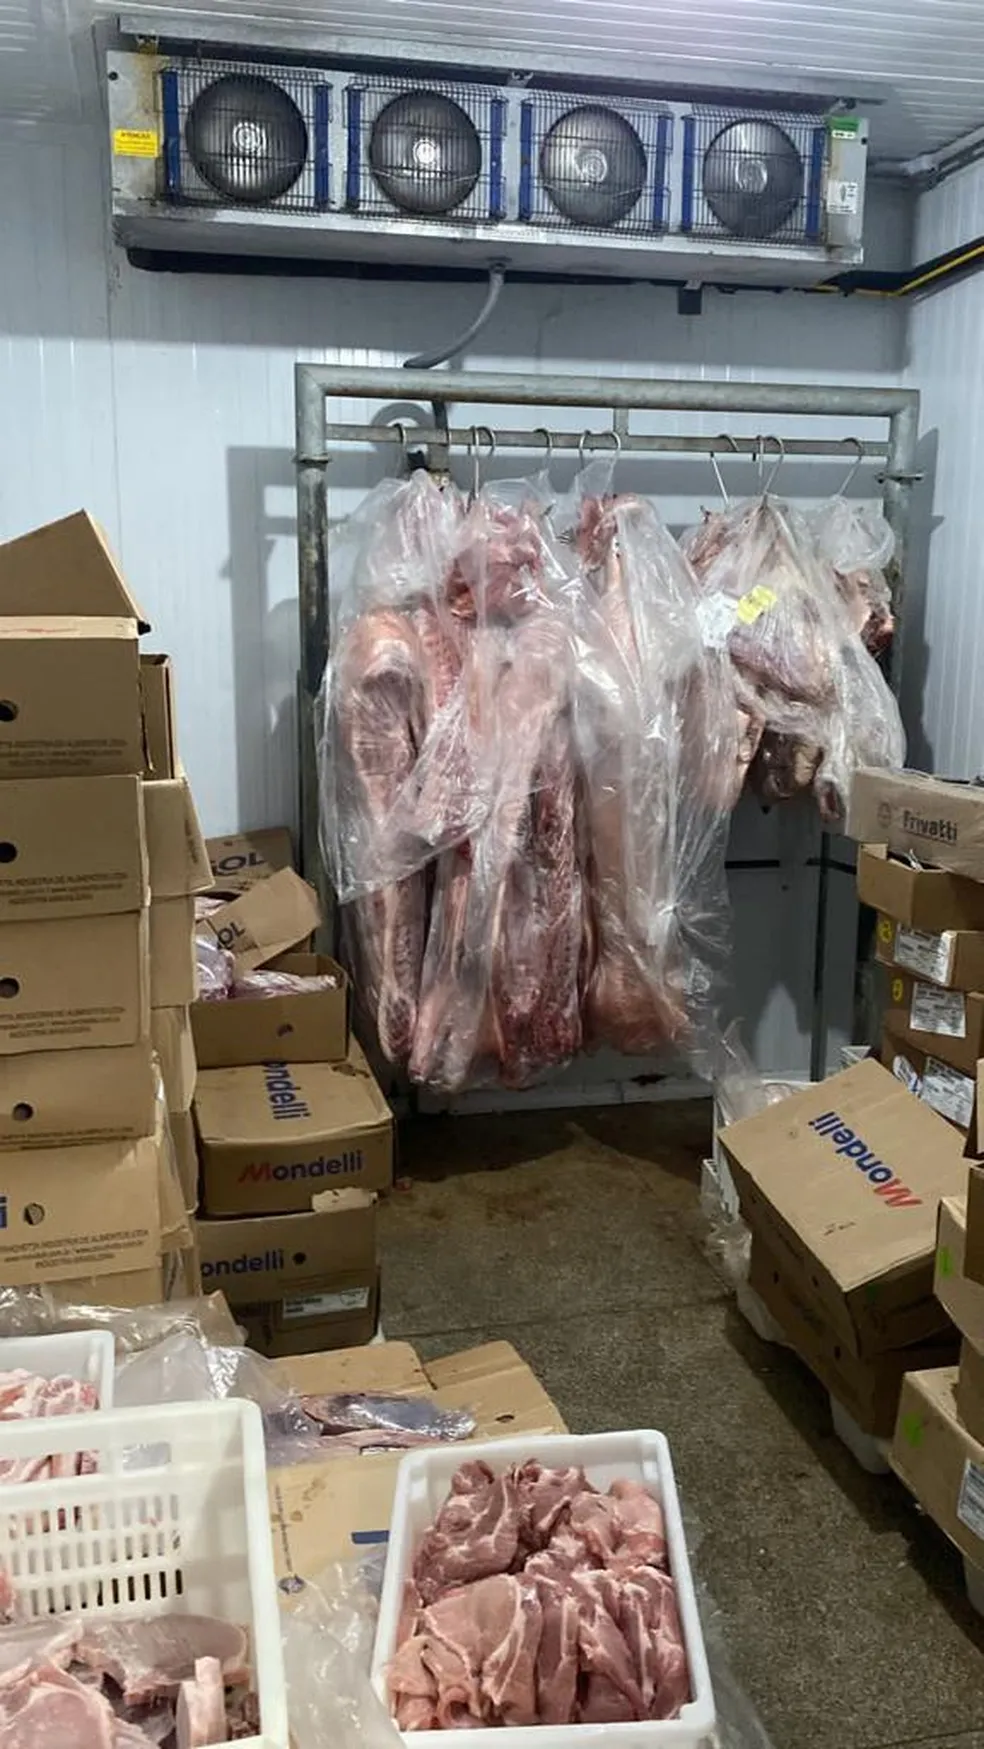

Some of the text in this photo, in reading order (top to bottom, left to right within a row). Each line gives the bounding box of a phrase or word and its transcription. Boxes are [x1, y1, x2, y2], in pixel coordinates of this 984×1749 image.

[238, 1151, 363, 1183] Mondelli
[808, 1112, 922, 1207] Mondelli
[201, 1249, 284, 1277] ondelli
